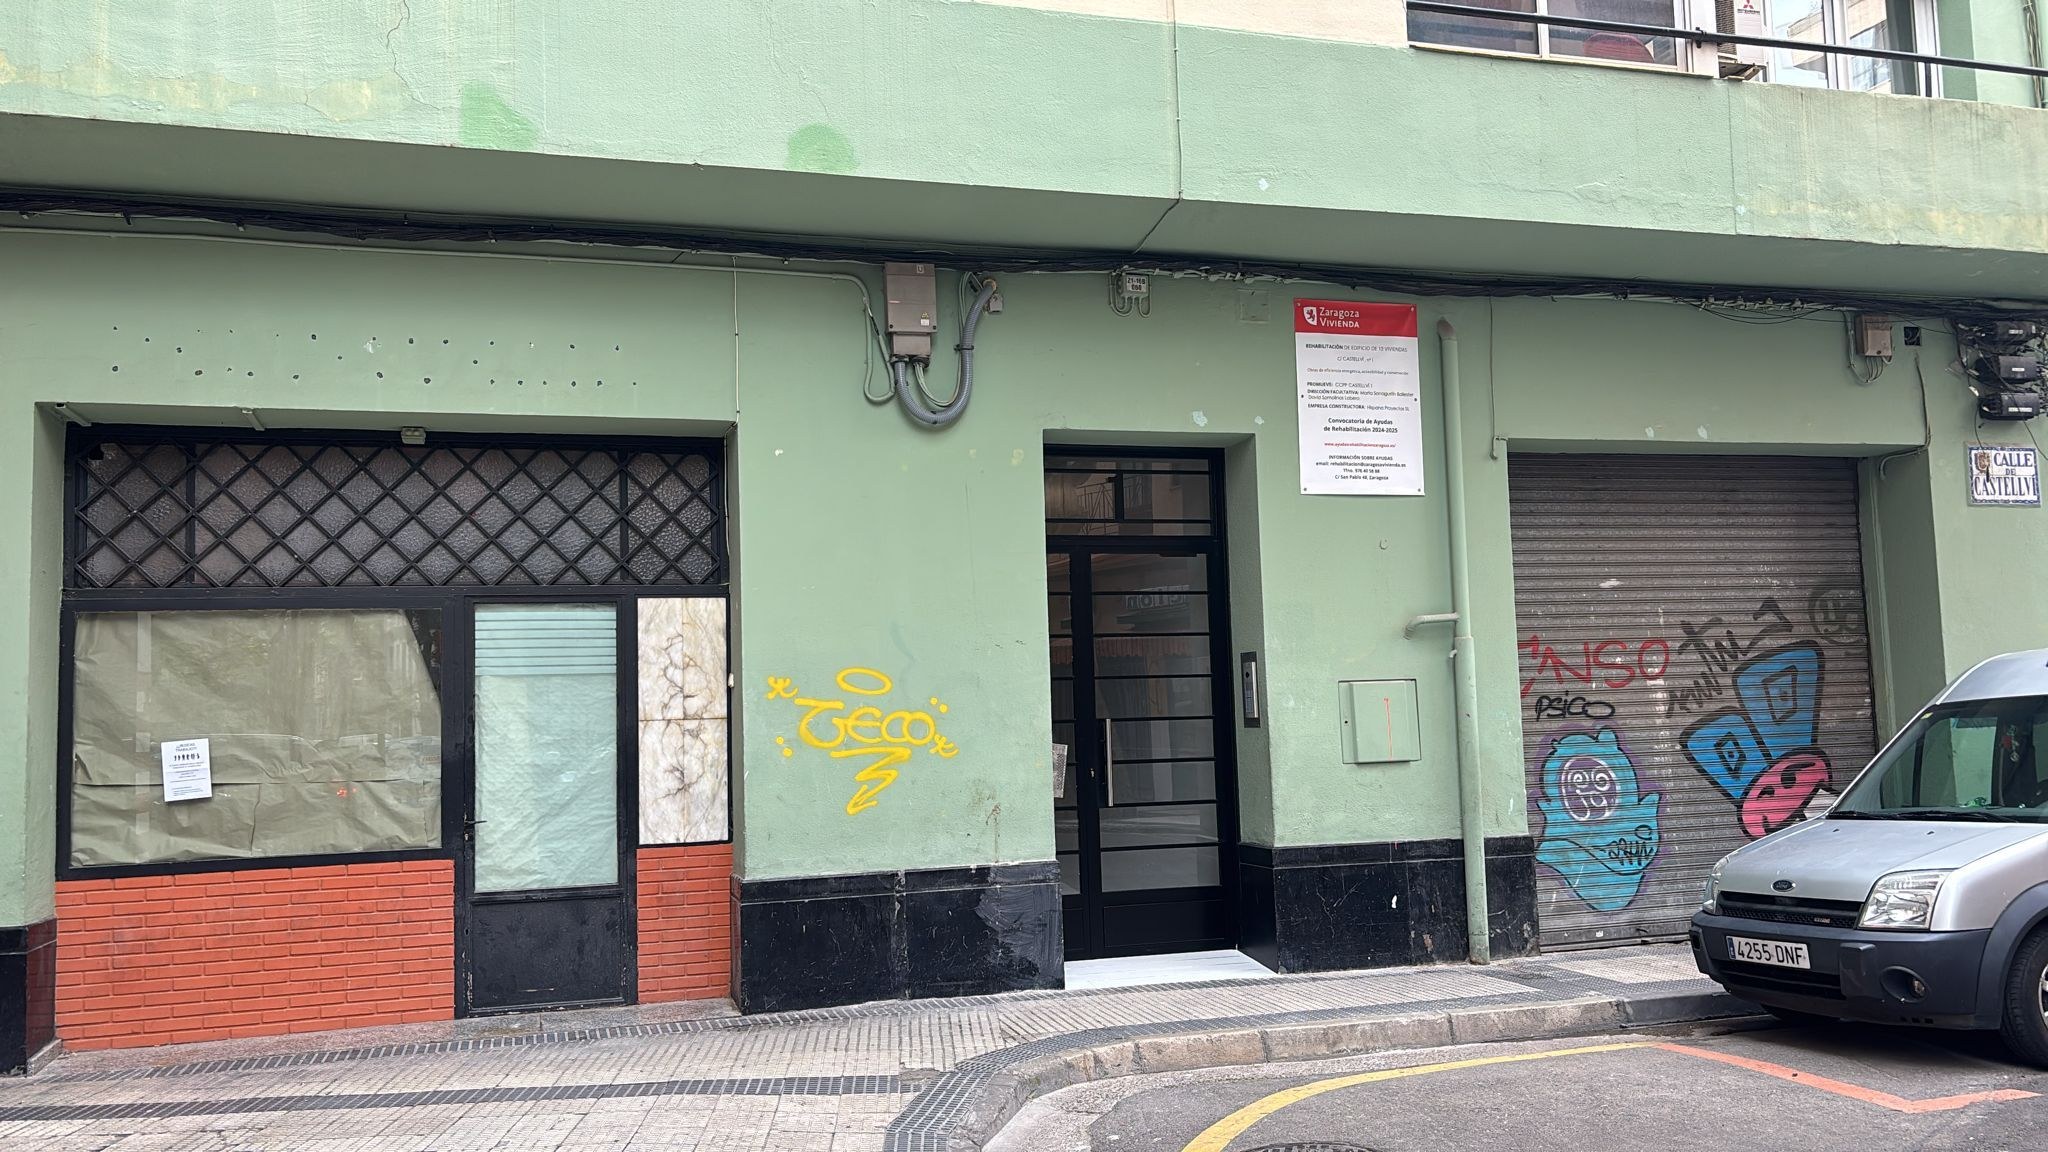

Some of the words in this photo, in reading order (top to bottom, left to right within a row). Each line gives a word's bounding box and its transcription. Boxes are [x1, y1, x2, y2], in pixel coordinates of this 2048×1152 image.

[1319, 306, 1360, 320] Zaragoza
[1319, 317, 1360, 328] VIVIENDA
[1993, 452, 2033, 467] CALLE
[2005, 468, 2016, 476] DE
[1737, 940, 1772, 962] 4255
[1775, 945, 1804, 965] DNF
